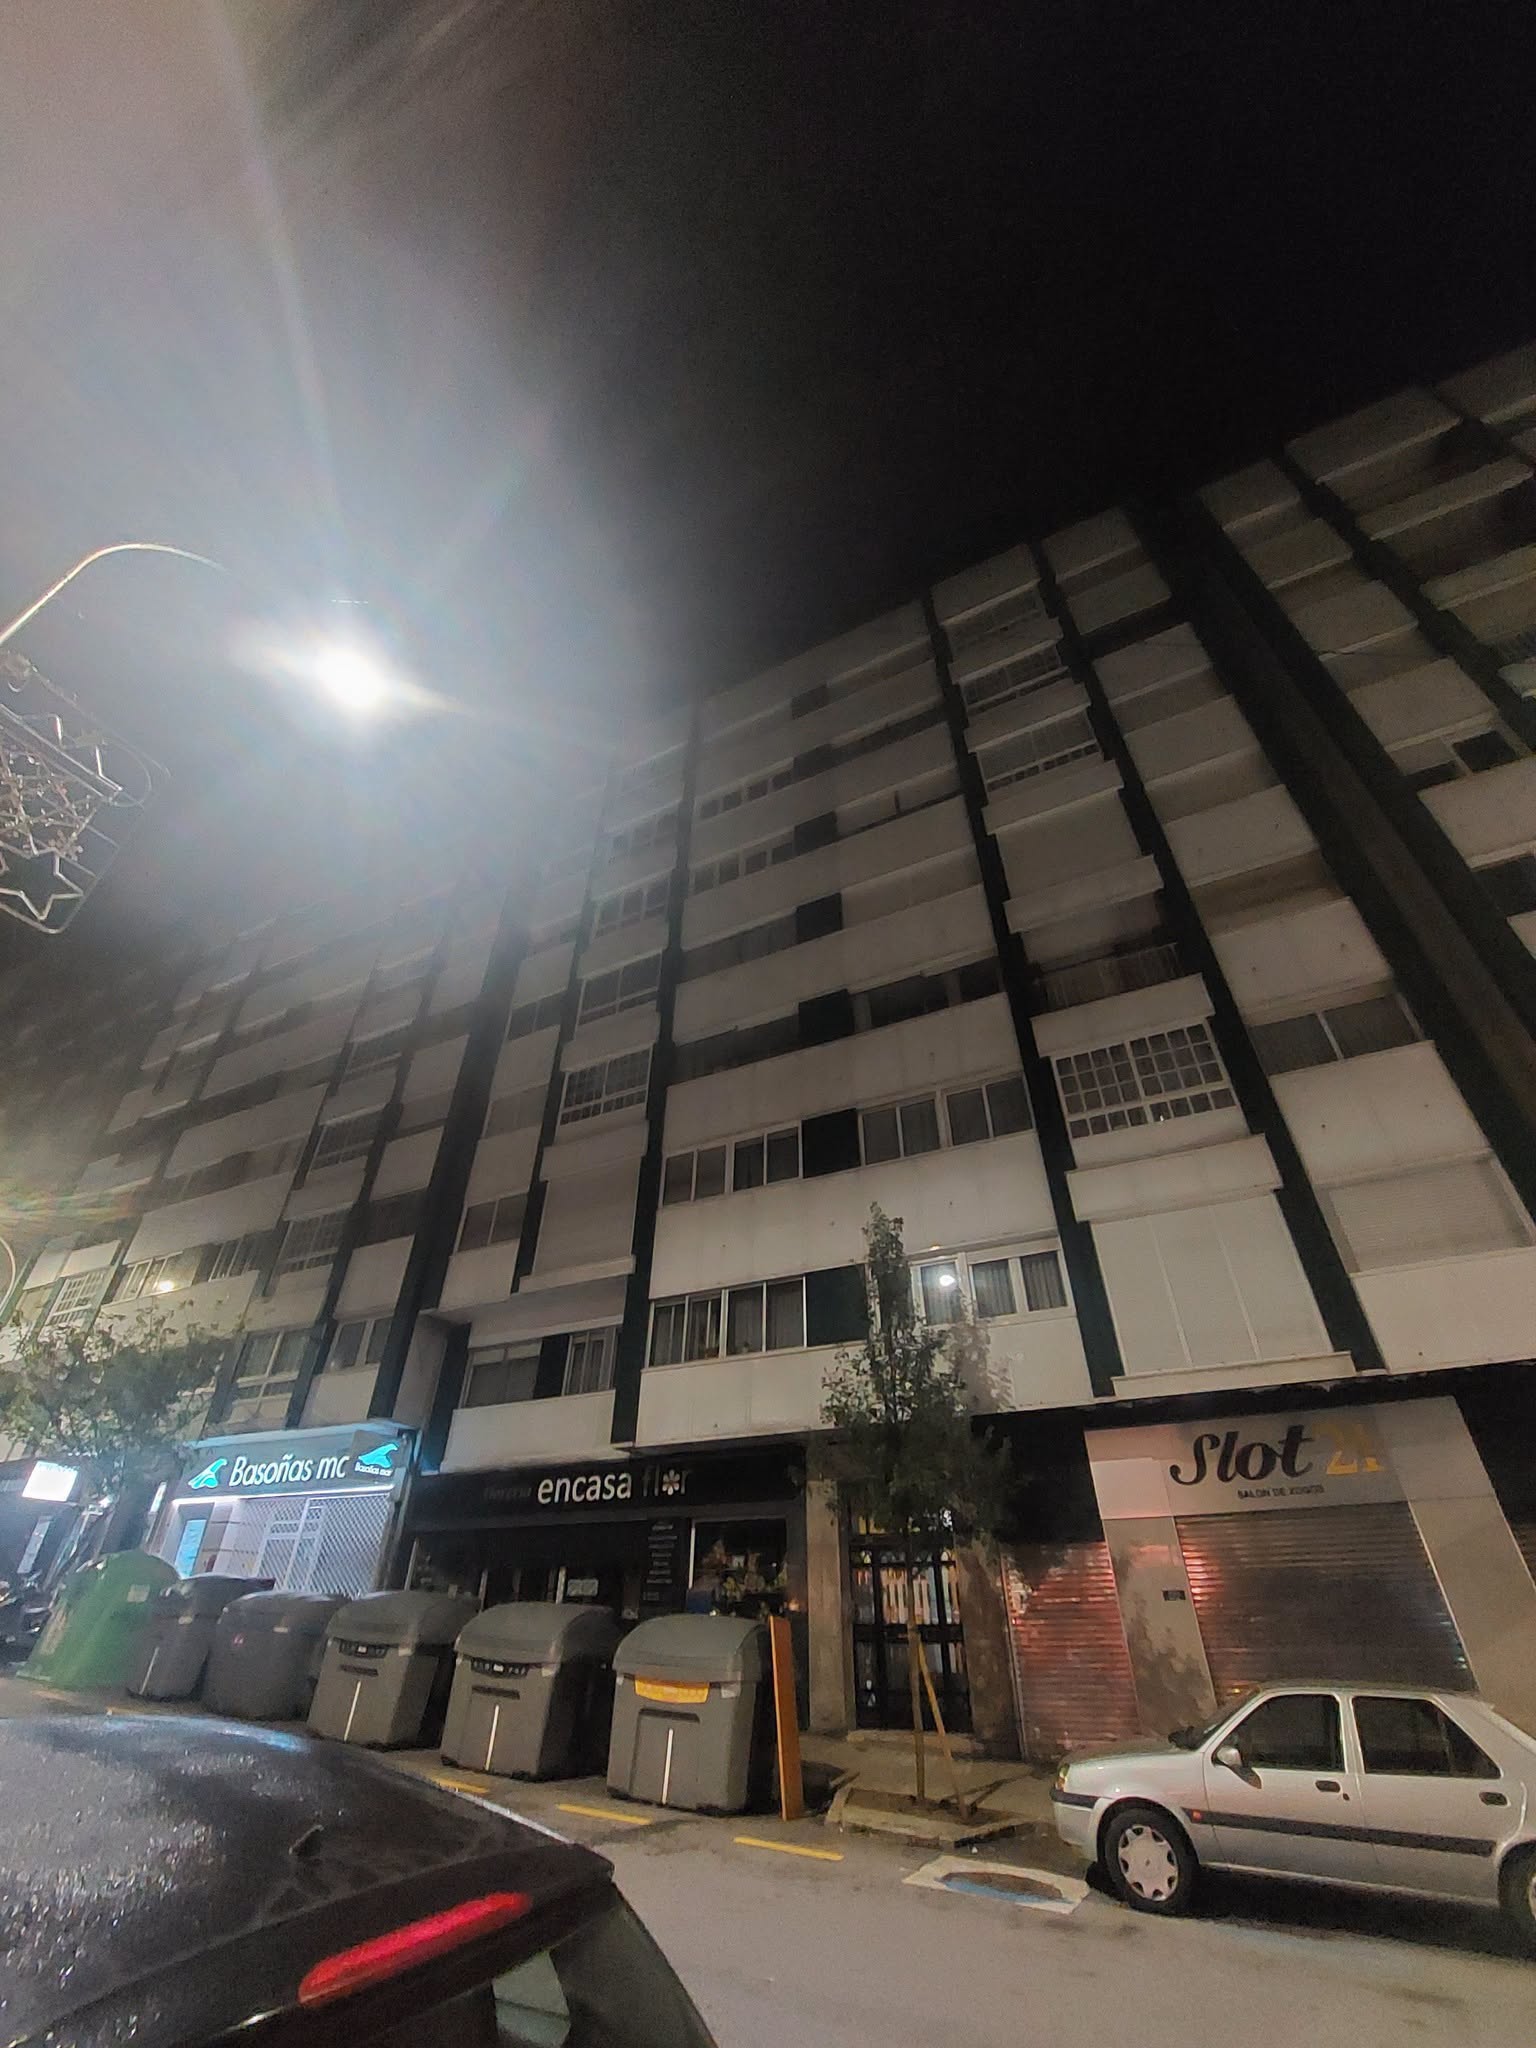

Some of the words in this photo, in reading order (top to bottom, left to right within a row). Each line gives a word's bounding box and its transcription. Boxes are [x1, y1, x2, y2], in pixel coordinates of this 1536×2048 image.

[229, 1453, 313, 1487] Basoñas
[316, 1455, 350, 1480] mc
[1170, 1425, 1314, 1486] Slot
[537, 1472, 632, 1505] encasa
